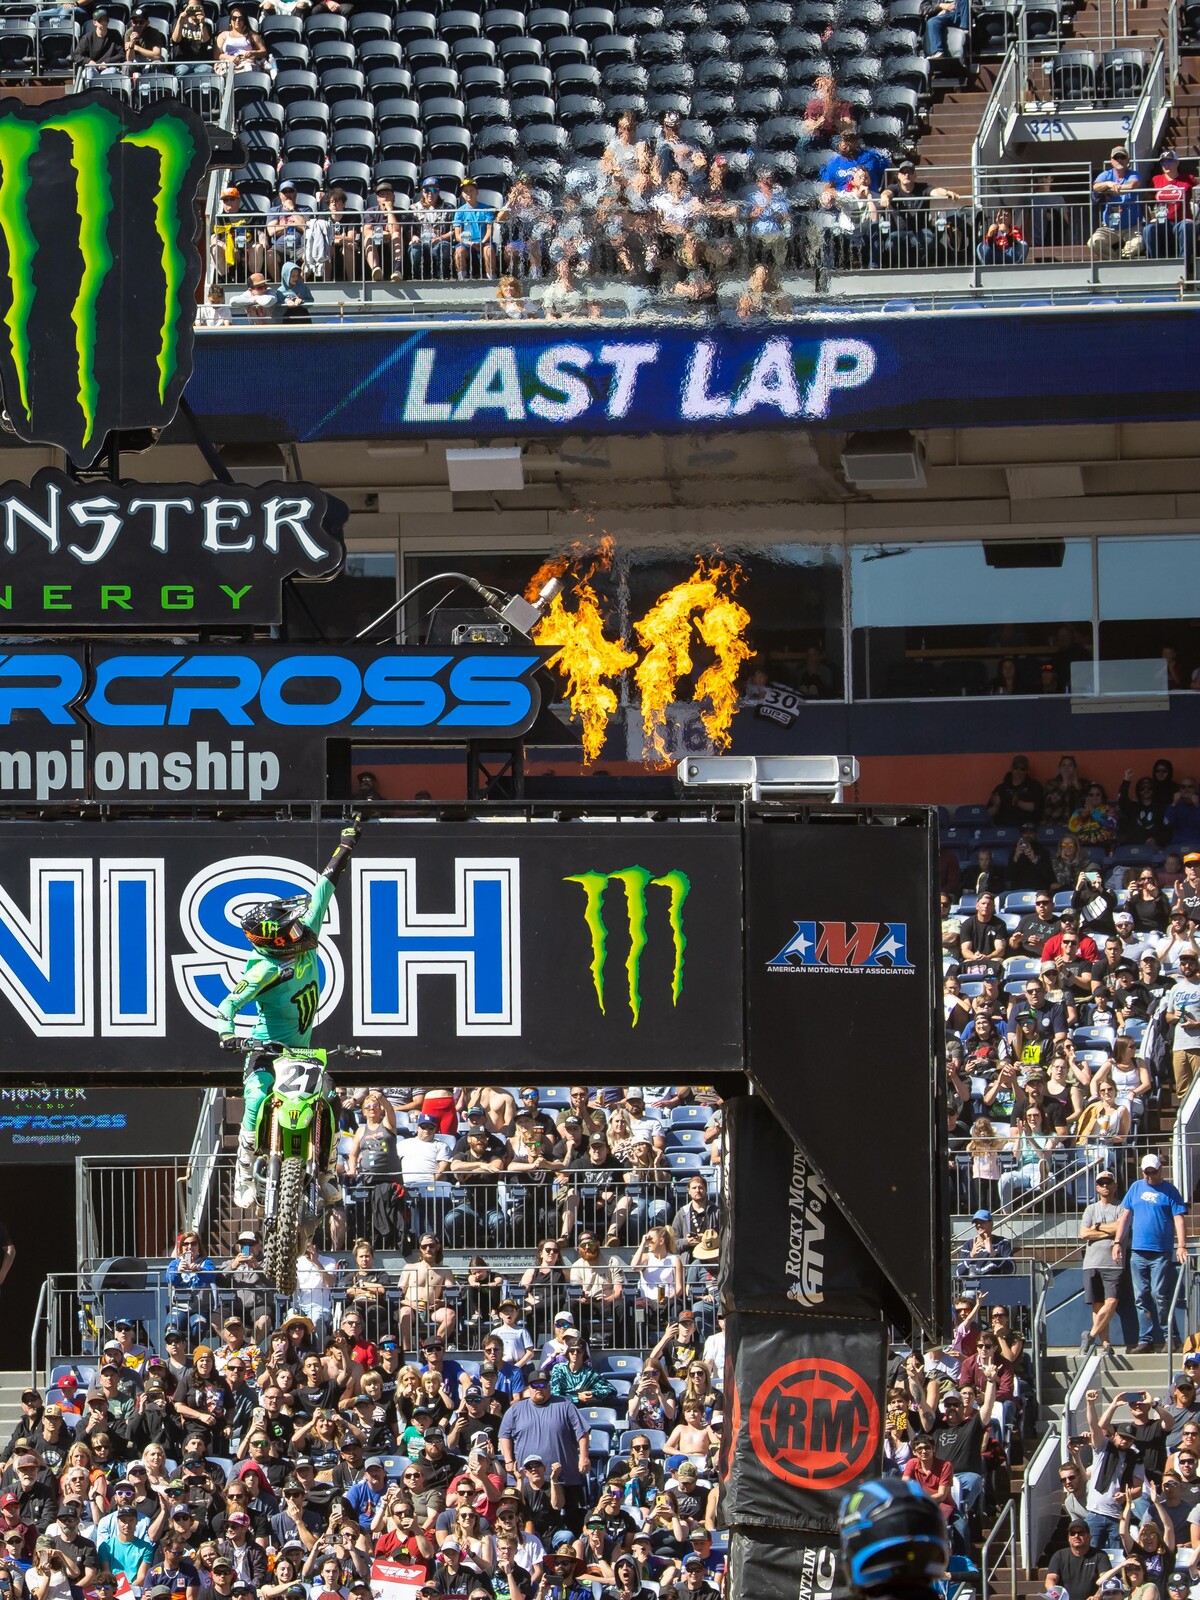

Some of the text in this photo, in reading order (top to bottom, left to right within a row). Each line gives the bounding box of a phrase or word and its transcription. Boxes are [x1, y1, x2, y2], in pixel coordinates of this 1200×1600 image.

[1031, 119, 1063, 136] 325
[403, 335, 879, 422] LAST LAP
[765, 690, 797, 711] 30
[765, 921, 916, 967] AMA
[807, 966, 864, 974] MOTORCYCLIST
[865, 967, 915, 975] ASSOCIATION
[278, 1064, 322, 1094] 21
[785, 1146, 807, 1279] ROCKY MOUN
[774, 1395, 858, 1453] RM
